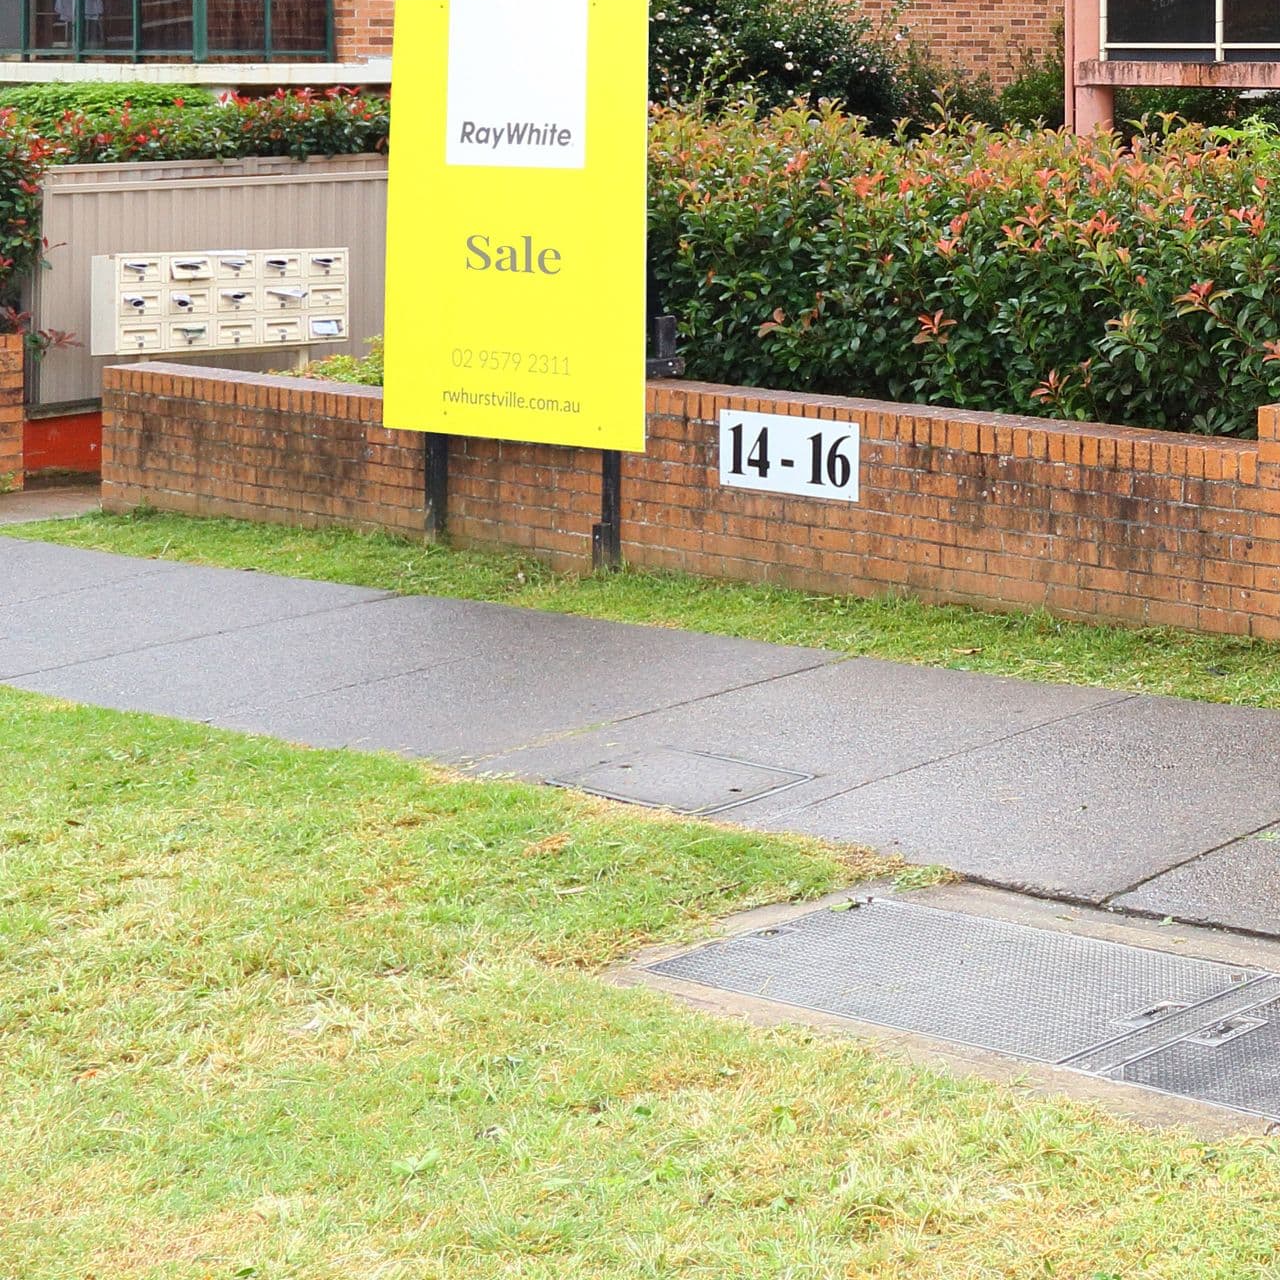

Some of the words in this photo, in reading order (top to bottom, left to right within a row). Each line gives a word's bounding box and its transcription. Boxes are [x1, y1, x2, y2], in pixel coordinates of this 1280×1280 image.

[460, 120, 572, 149] RayWhite
[466, 235, 562, 275] Sale
[452, 348, 473, 369] 02
[479, 351, 522, 373] 9579
[527, 353, 571, 376] 2311
[442, 388, 580, 413] rwhurstville.com.au
